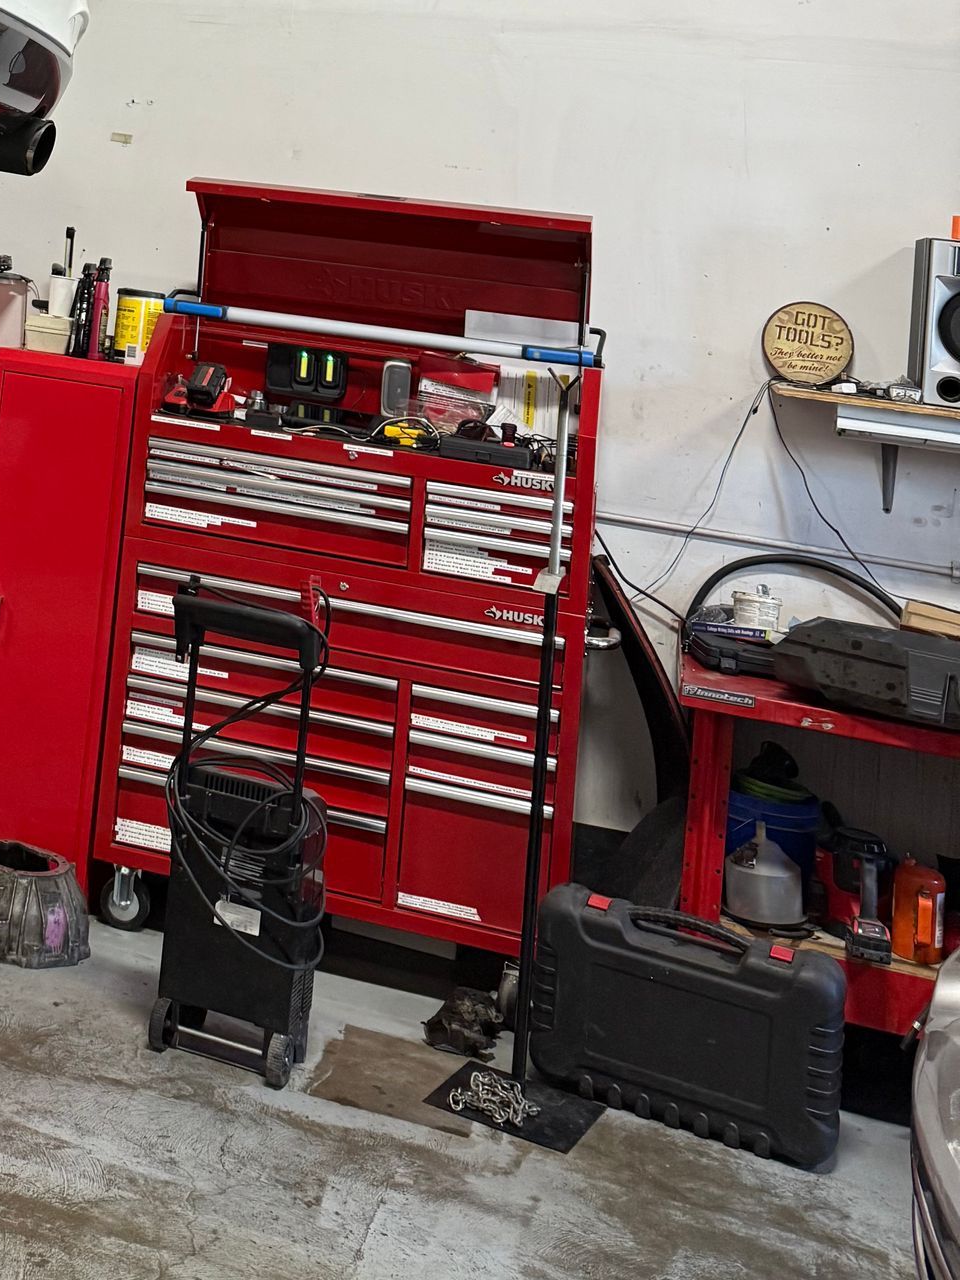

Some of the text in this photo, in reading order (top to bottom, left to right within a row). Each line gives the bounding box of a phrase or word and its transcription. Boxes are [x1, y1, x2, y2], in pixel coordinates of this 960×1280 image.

[794, 310, 832, 331] GOT
[775, 324, 844, 351] TOOLS?
[770, 347, 843, 362] They better not
[787, 361, 830, 373] be mine!
[502, 609, 544, 626] HUSK
[696, 688, 753, 705] innotech
